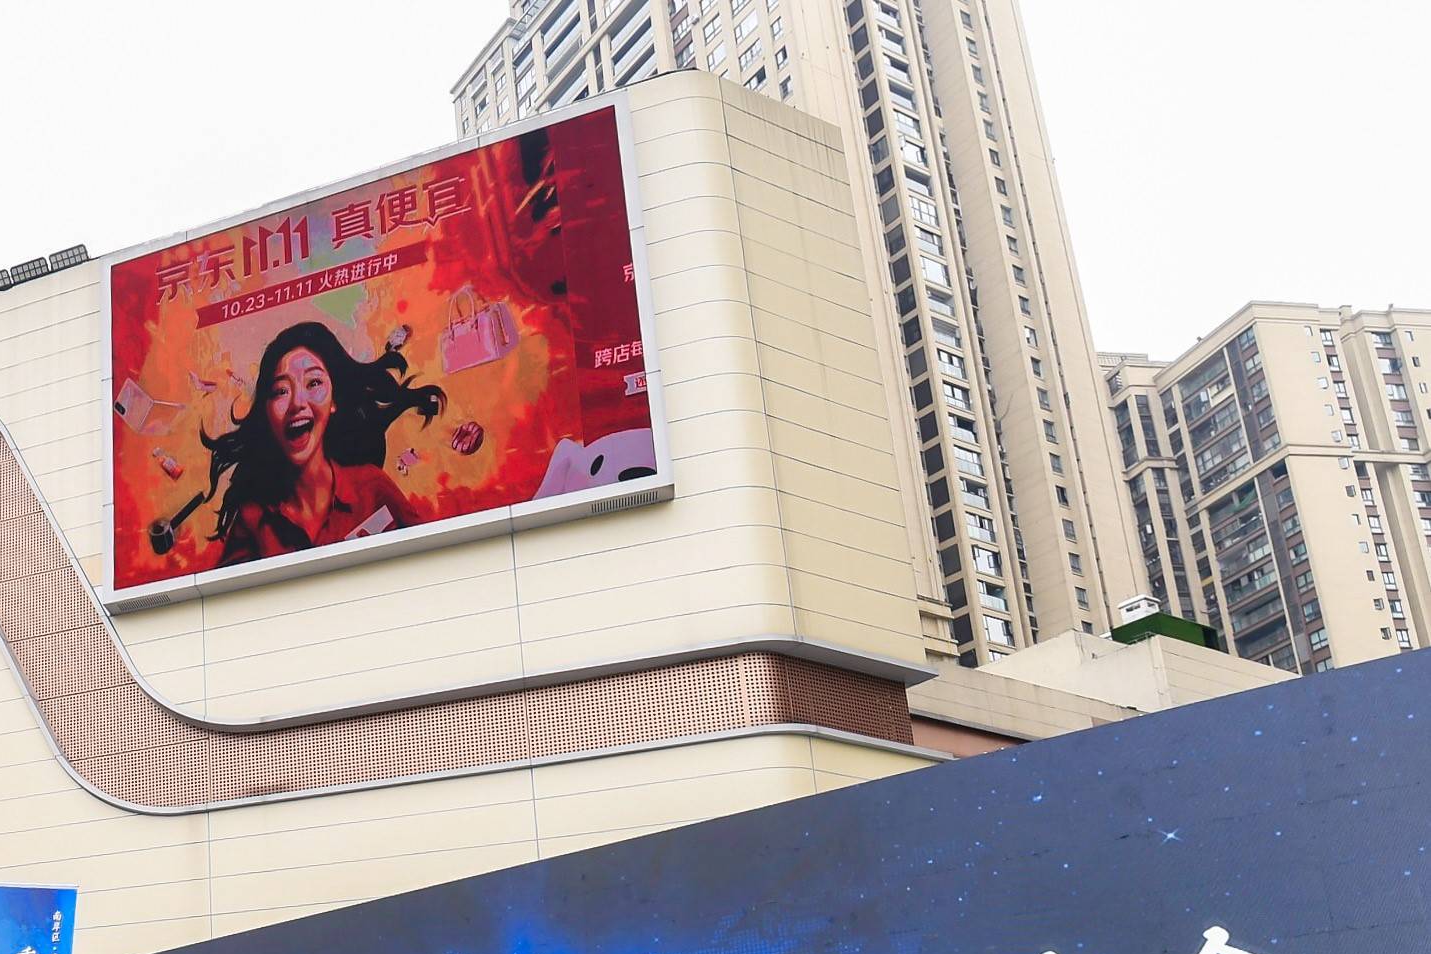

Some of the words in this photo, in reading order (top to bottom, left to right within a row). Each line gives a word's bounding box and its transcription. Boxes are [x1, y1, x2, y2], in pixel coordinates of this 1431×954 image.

[331, 176, 472, 250] 真便宜
[221, 279, 313, 318] 10.23-11.11
[318, 253, 399, 292] 火热进行中
